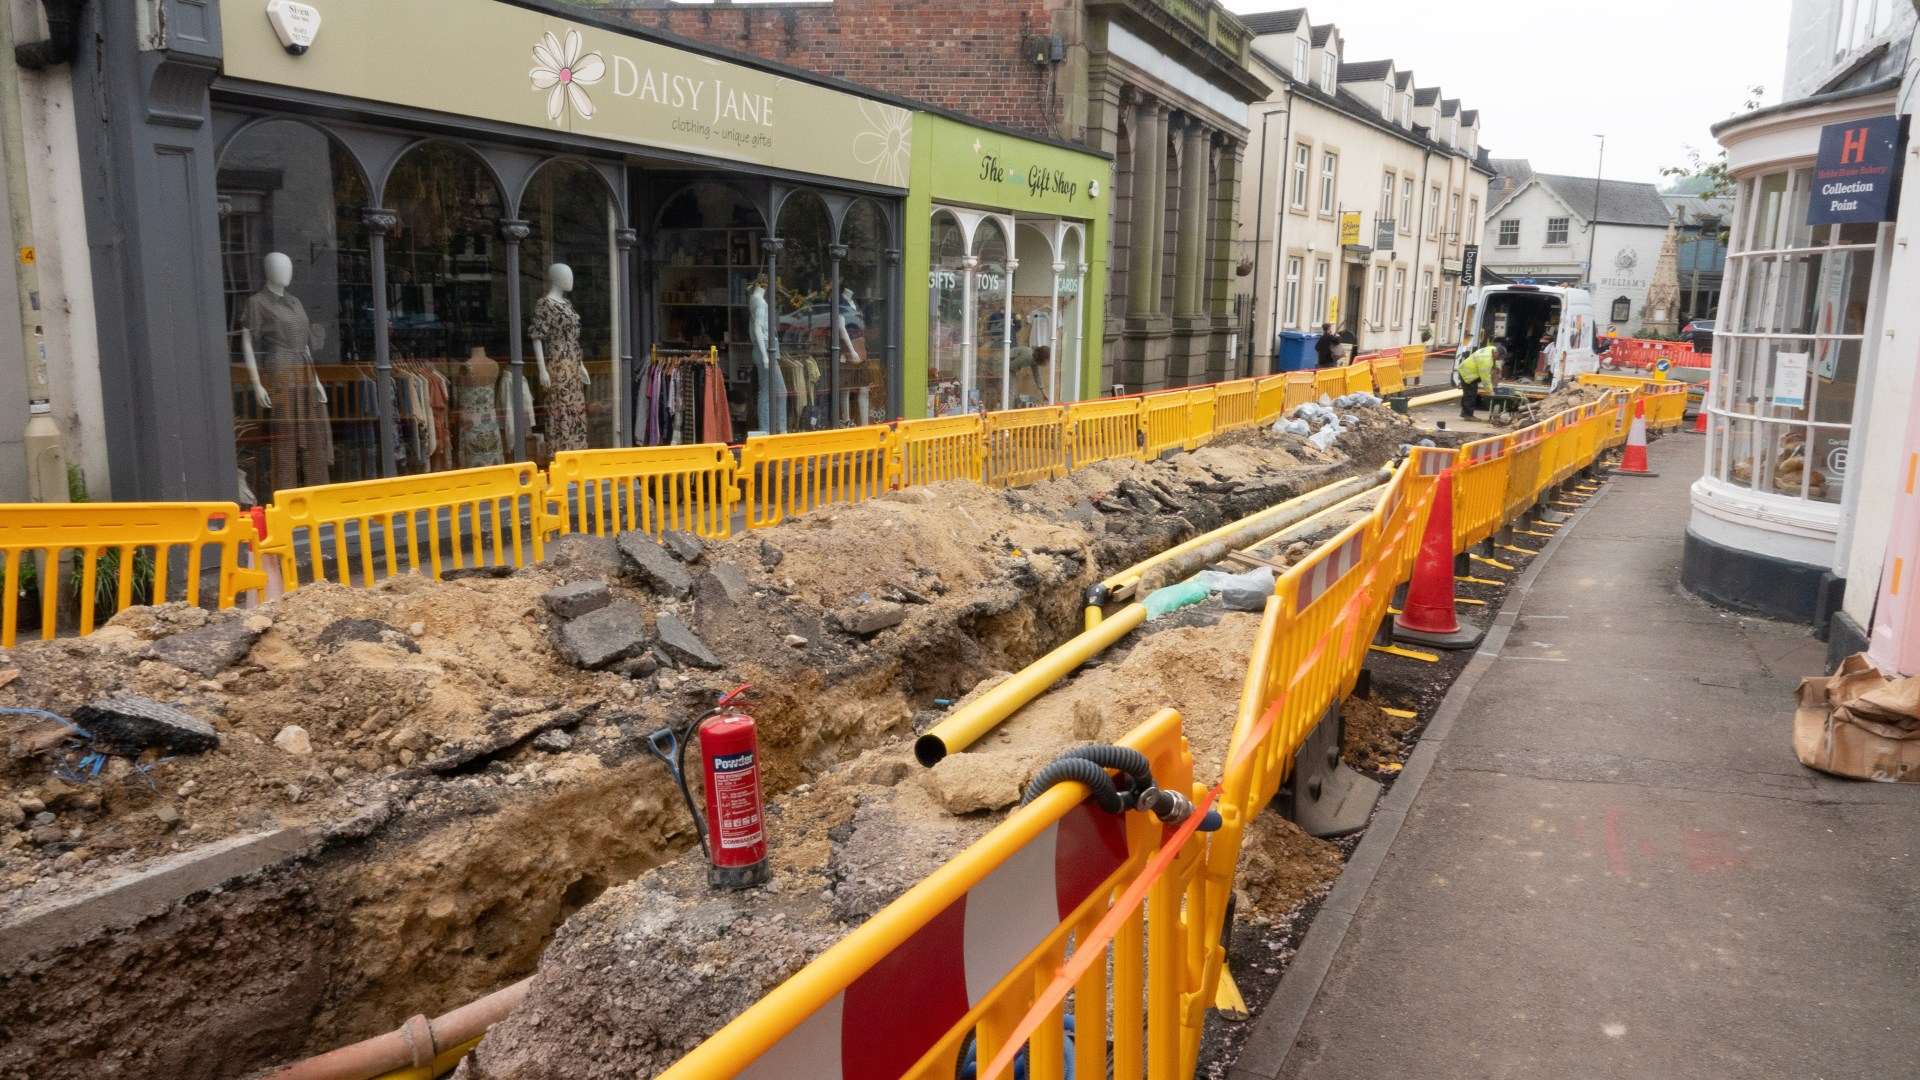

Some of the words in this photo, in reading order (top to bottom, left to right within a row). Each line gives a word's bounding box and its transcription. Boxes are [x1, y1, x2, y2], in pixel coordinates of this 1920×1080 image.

[612, 54, 704, 112] DAISY
[713, 80, 774, 127] JANE
[671, 117, 711, 139] clothing
[721, 128, 750, 147] unique
[751, 134, 772, 149] gifts
[1840, 128, 1869, 164] H
[979, 155, 1004, 183] The
[1028, 165, 1050, 198] Gift
[1052, 170, 1077, 203] Shop
[1822, 181, 1874, 195] Collection
[1830, 199, 1858, 211] Point
[25, 250, 34, 260] 4
[1462, 251, 1477, 283] beauty
[928, 271, 956, 289] GIFTS
[977, 274, 999, 290] TOYS
[1601, 279, 1647, 288] WILLIAM'S
[714, 755, 753, 769] Powder
